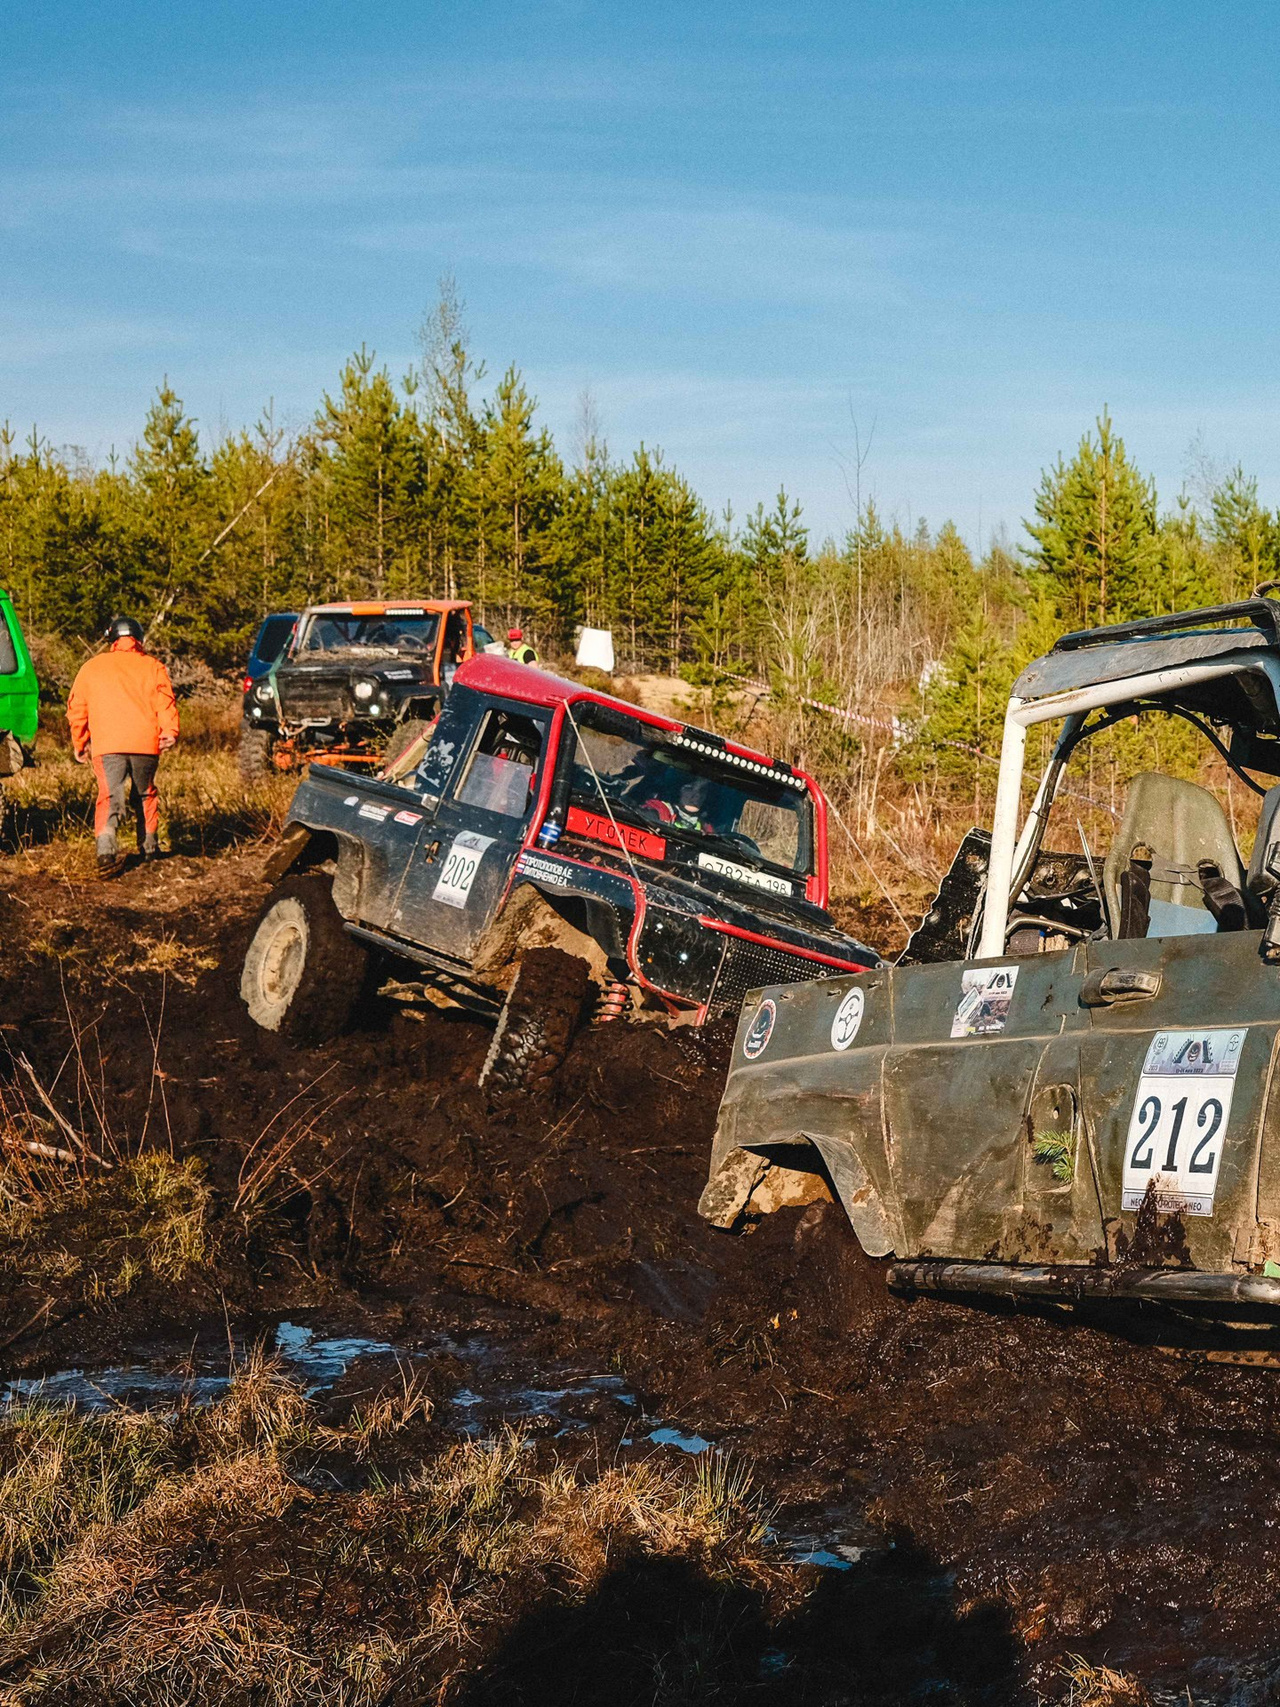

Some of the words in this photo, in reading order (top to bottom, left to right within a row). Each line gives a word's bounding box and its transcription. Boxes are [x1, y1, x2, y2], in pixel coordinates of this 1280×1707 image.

[585, 816, 647, 851] УГОЛЁК
[442, 855, 475, 891] 202
[1130, 1096, 1223, 1174] 212
[1189, 1202, 1202, 1211] NEO
